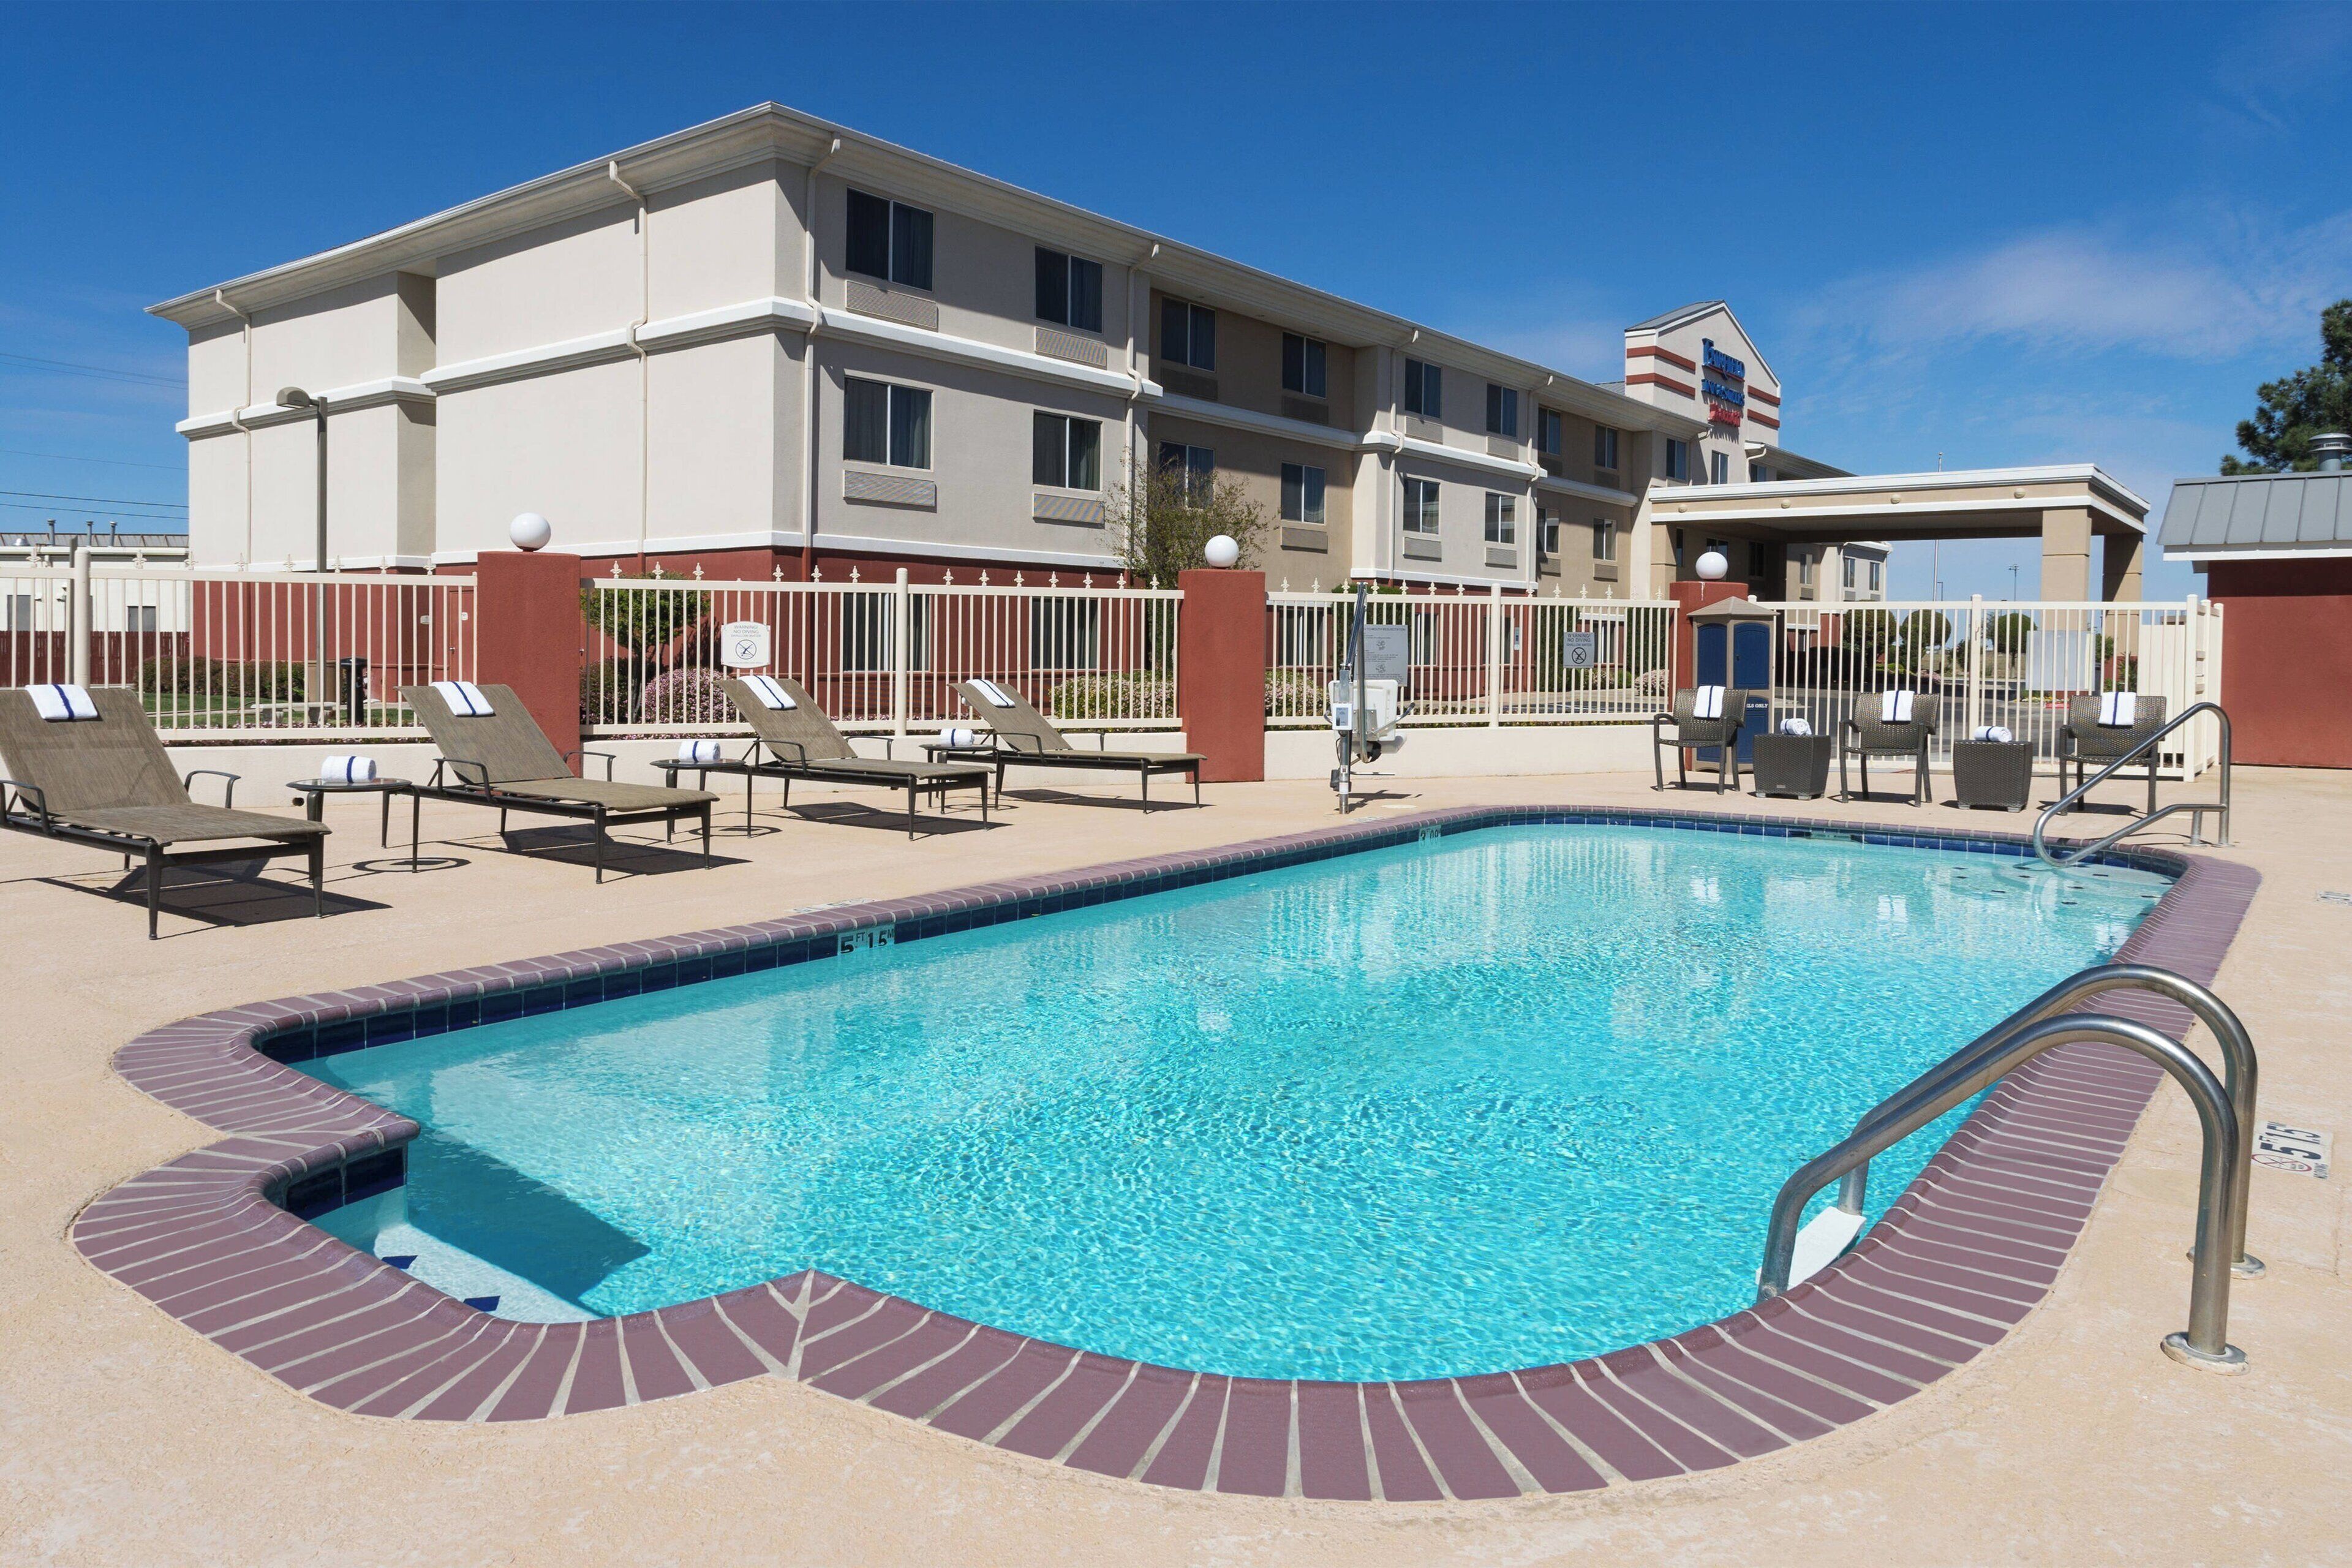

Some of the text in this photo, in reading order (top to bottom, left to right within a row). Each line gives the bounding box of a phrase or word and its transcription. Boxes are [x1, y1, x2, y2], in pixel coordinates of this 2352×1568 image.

[840, 935, 854, 954] 5
[856, 932, 865, 942] FT
[2260, 1142, 2321, 1159] 5
